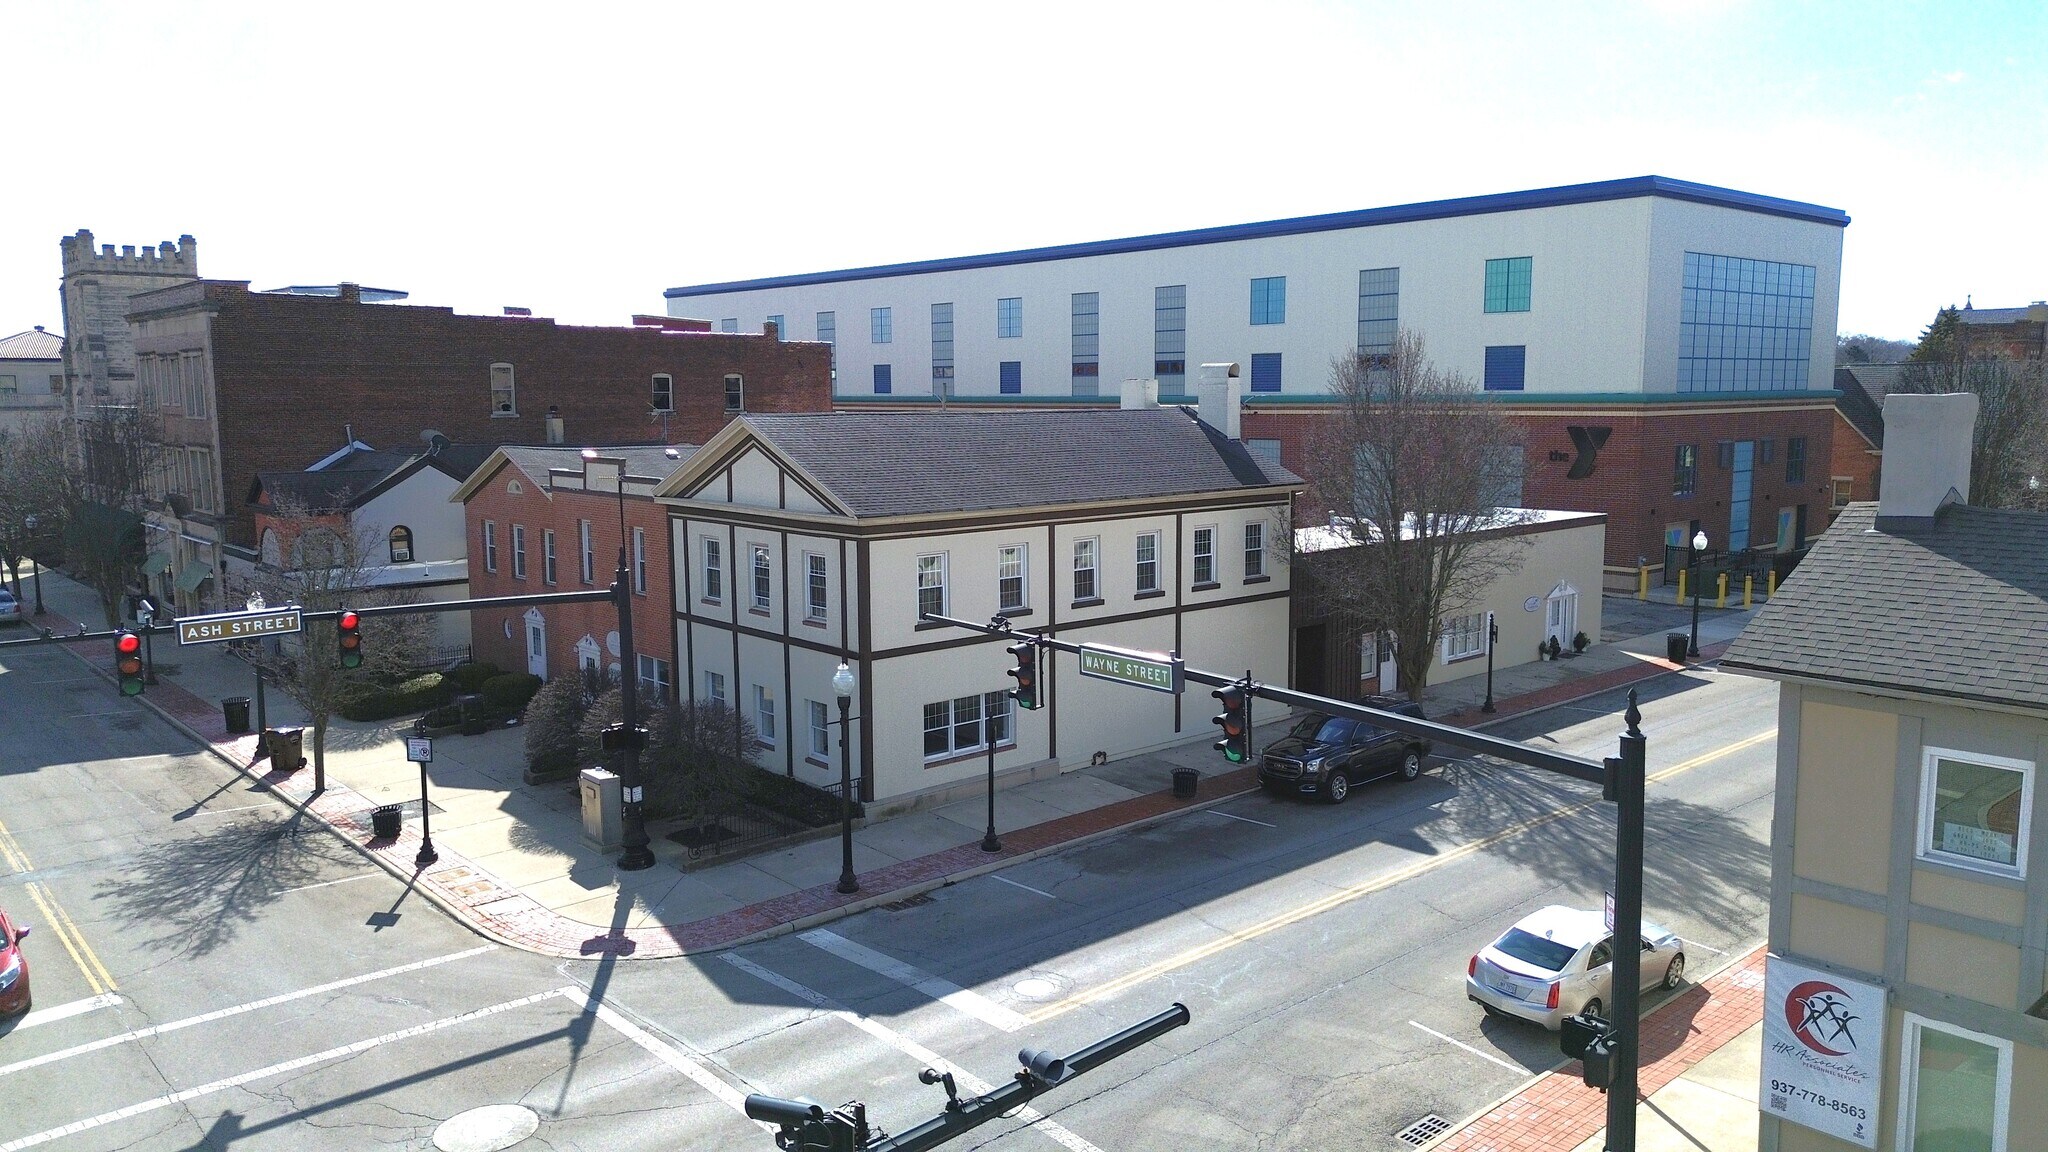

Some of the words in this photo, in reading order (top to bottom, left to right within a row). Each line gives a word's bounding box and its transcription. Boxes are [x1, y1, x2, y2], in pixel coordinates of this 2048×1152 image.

[1549, 450, 1569, 462] the
[187, 625, 222, 639] ASH
[232, 616, 295, 633] STREET
[1085, 655, 1120, 674] WAYNE
[1126, 664, 1168, 683] STREET
[1771, 1041, 1795, 1058] HR
[1795, 1049, 1871, 1079] Associates
[1802, 1061, 1836, 1076] PERSONNEL
[1837, 1073, 1861, 1084] SERVICE
[1771, 1079, 1867, 1120] 937-778-8563
